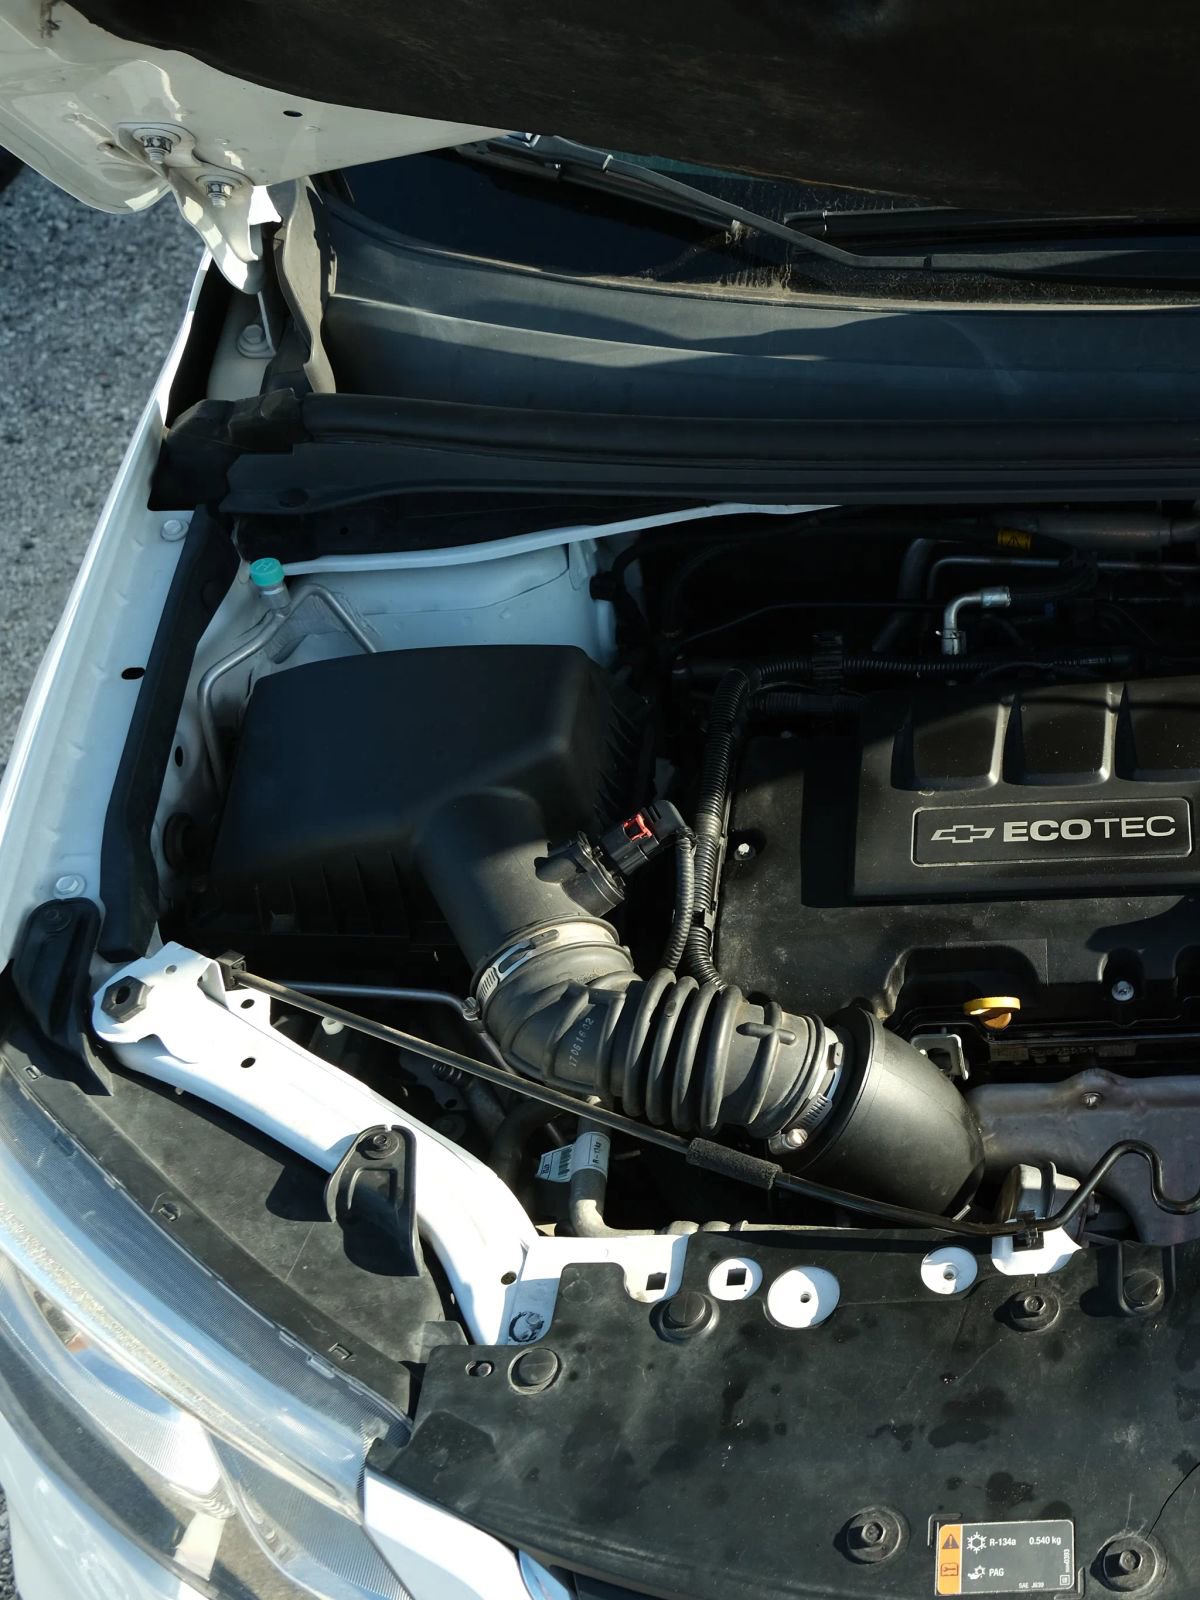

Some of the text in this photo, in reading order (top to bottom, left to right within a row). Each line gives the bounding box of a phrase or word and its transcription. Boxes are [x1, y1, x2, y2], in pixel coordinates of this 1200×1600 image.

[1003, 815, 1176, 842] ECOTEC
[989, 1535, 1062, 1547] R-134a 0.540 kg
[988, 1568, 1005, 1577] PAG
